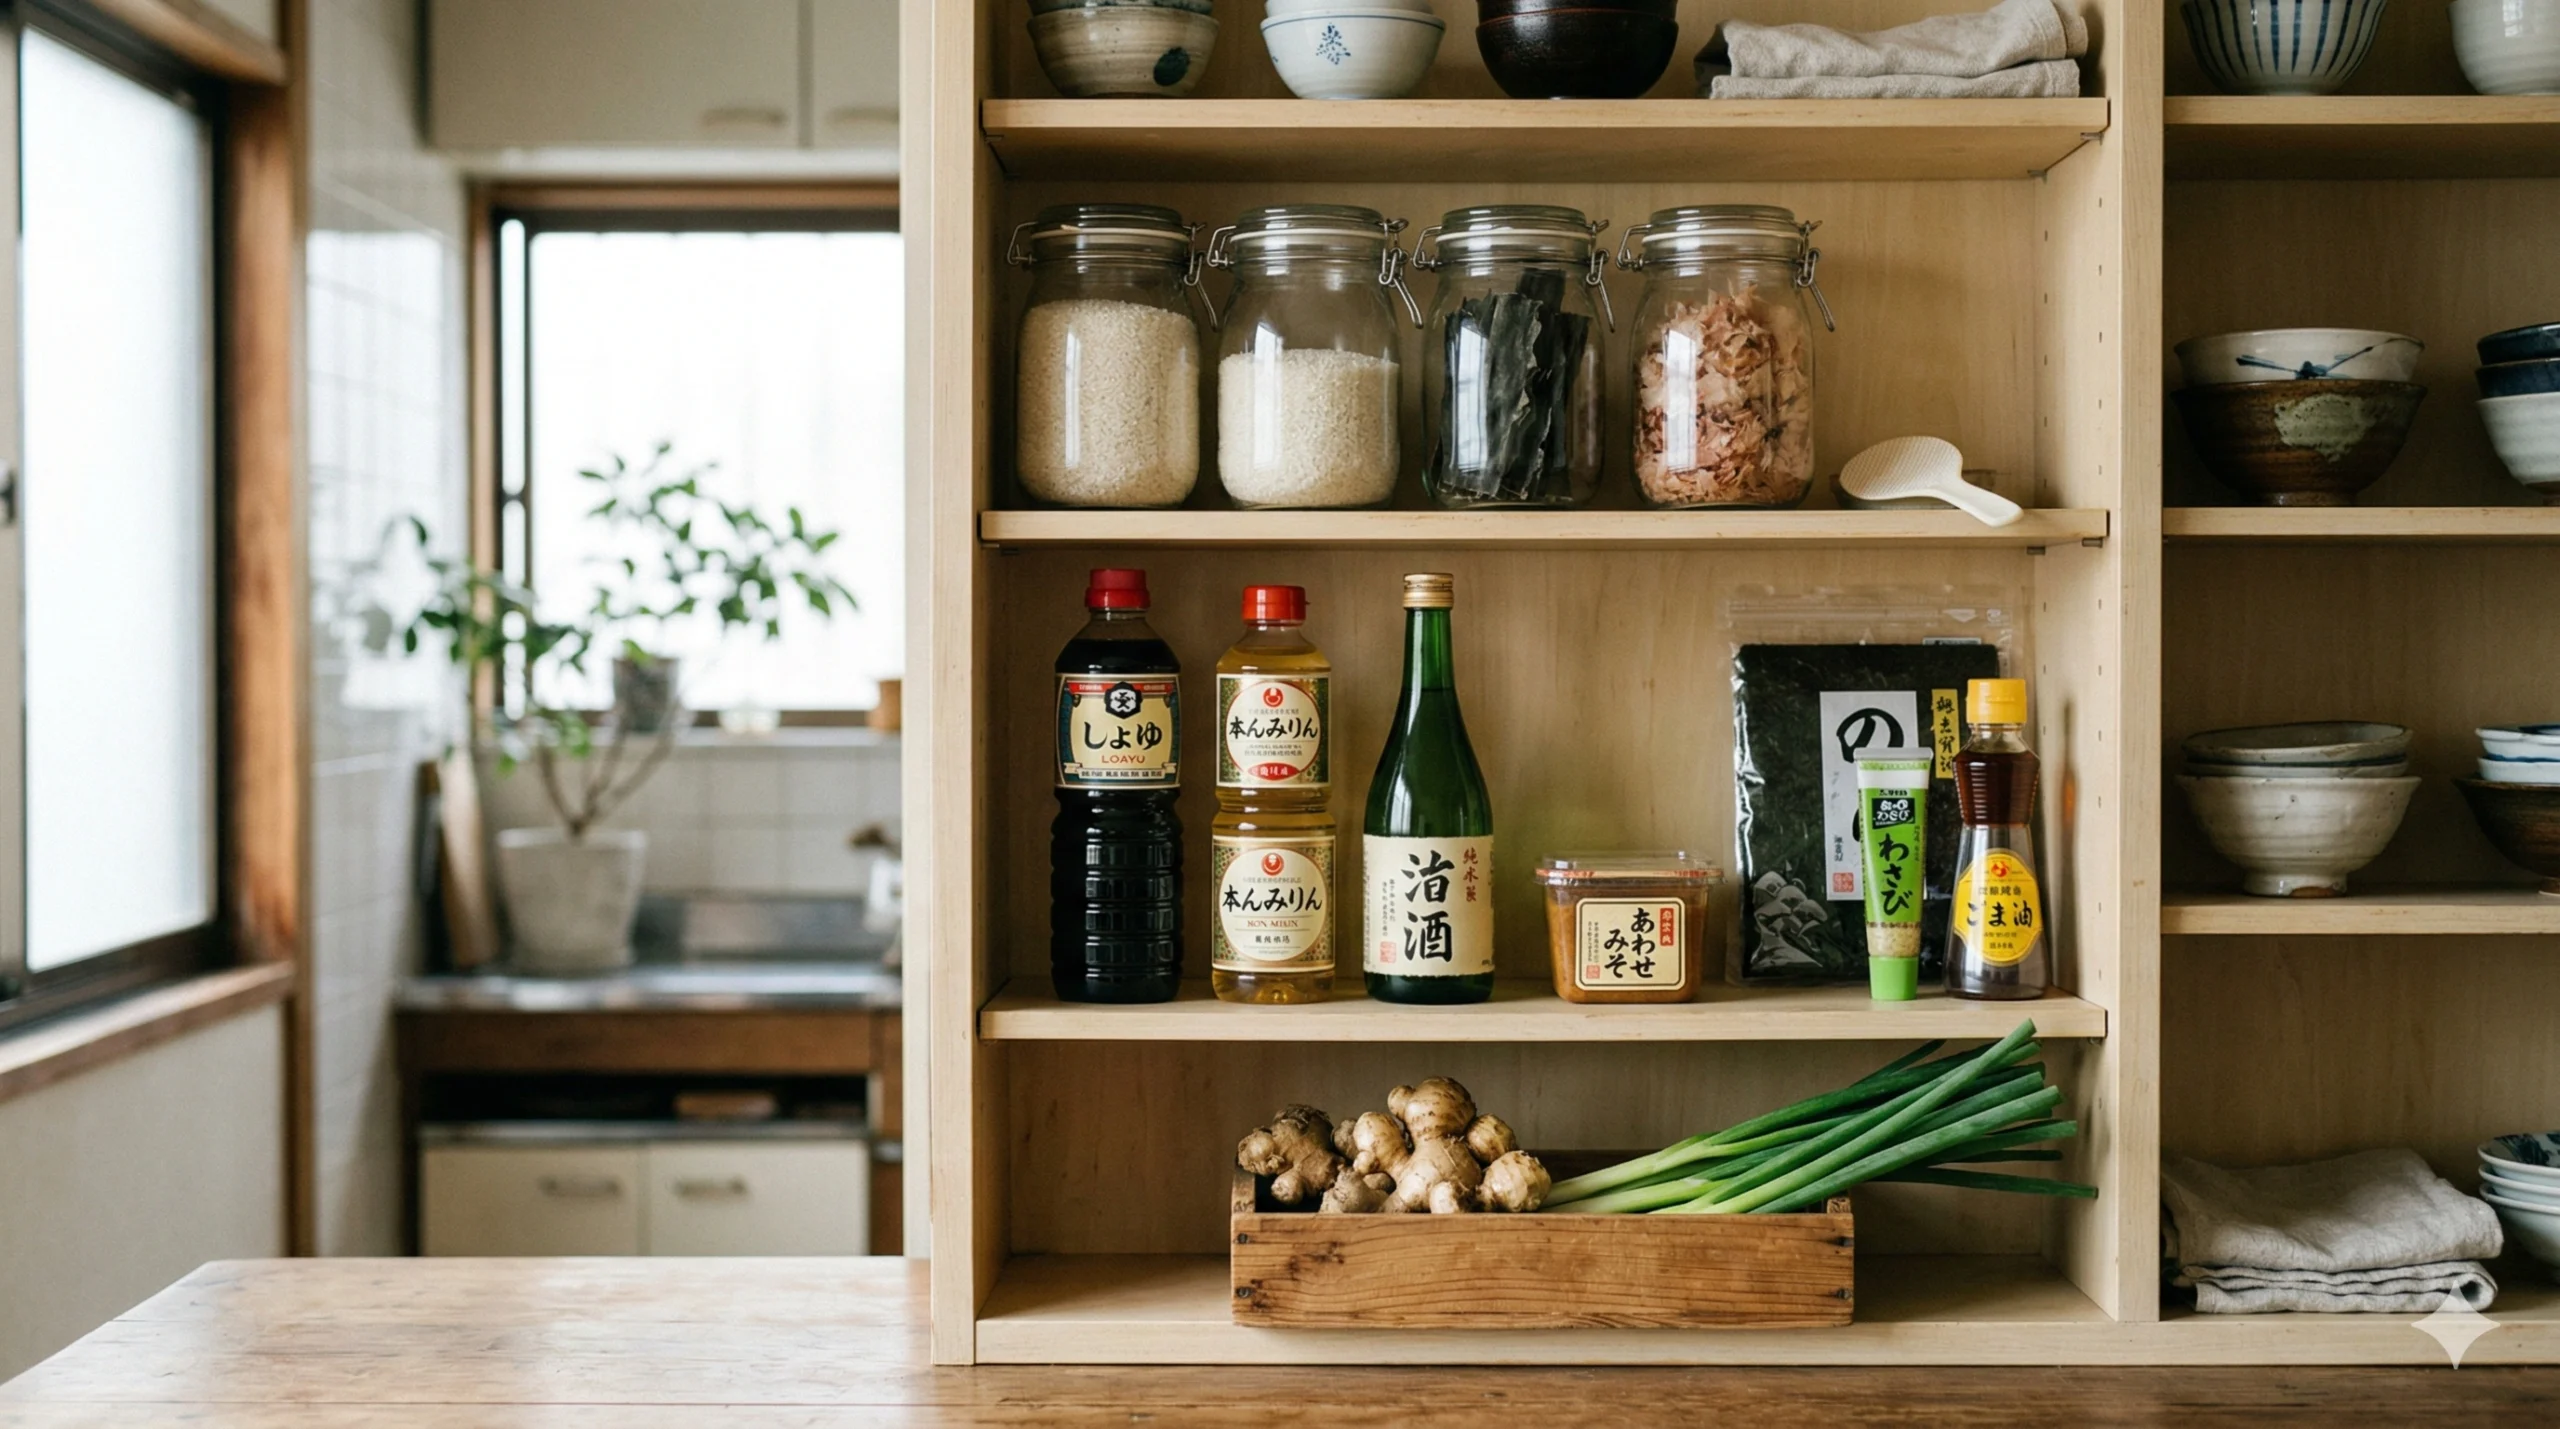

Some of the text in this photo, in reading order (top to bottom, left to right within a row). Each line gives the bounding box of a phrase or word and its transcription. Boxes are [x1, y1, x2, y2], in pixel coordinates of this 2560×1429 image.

[1084, 721, 1163, 750] しょゆ
[1229, 716, 1318, 739] 本んみりん
[1102, 755, 1145, 764] LOAYU
[1878, 833, 1913, 916] わさび
[1222, 884, 1323, 912] 本んみりん
[1966, 900, 2033, 928] ごま油
[1604, 930, 1630, 979] みそ
[1630, 908, 1656, 979] あわせ
